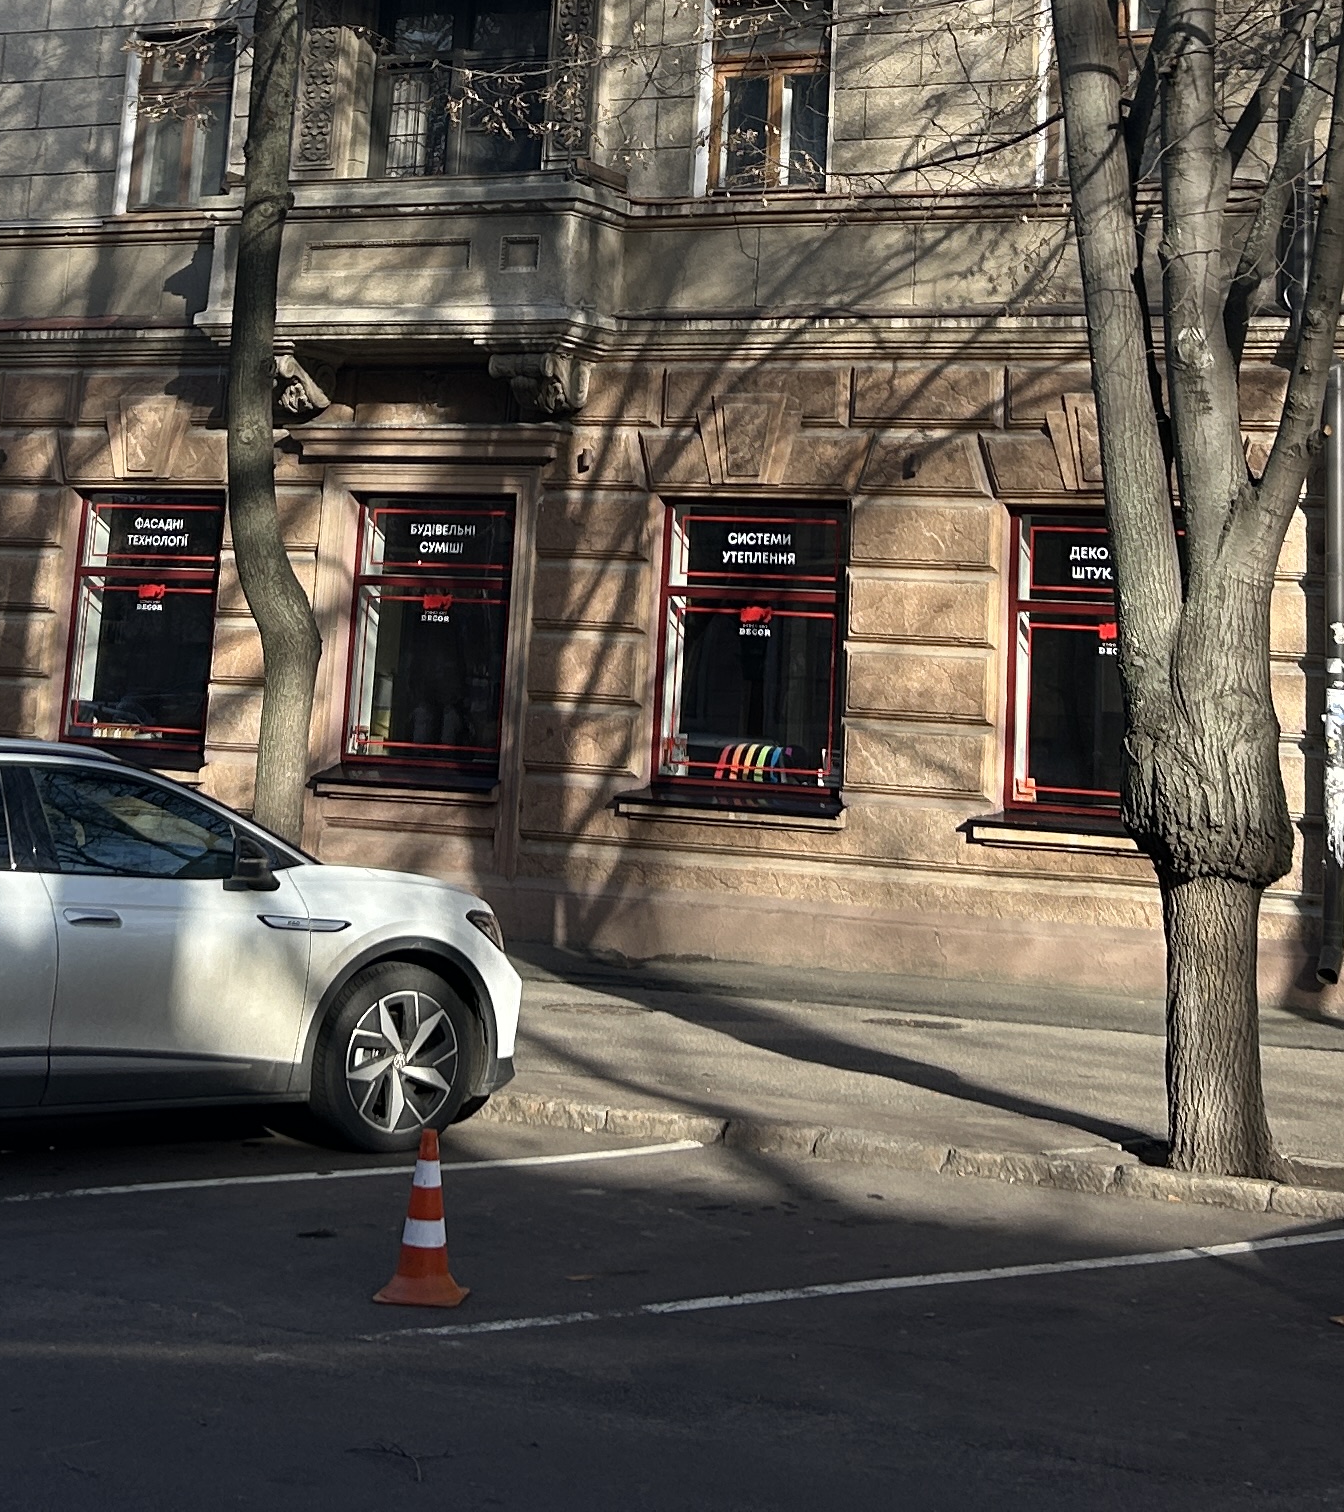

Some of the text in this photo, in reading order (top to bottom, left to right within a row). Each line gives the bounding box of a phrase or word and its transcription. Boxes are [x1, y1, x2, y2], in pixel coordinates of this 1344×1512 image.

[134, 516, 184, 531] ФАСАДНІ
[410, 523, 476, 537] БУДІВЕЛЬНІ
[127, 533, 189, 547] ТЕХНОЛОГІЇ
[727, 532, 791, 546] СИСТЕМИ
[419, 541, 463, 554] СУМІШІ
[1069, 546, 1111, 561] ДЕКО
[722, 550, 796, 565] УТЕПЛЕННЯ
[1071, 565, 1114, 580] ШТУК
